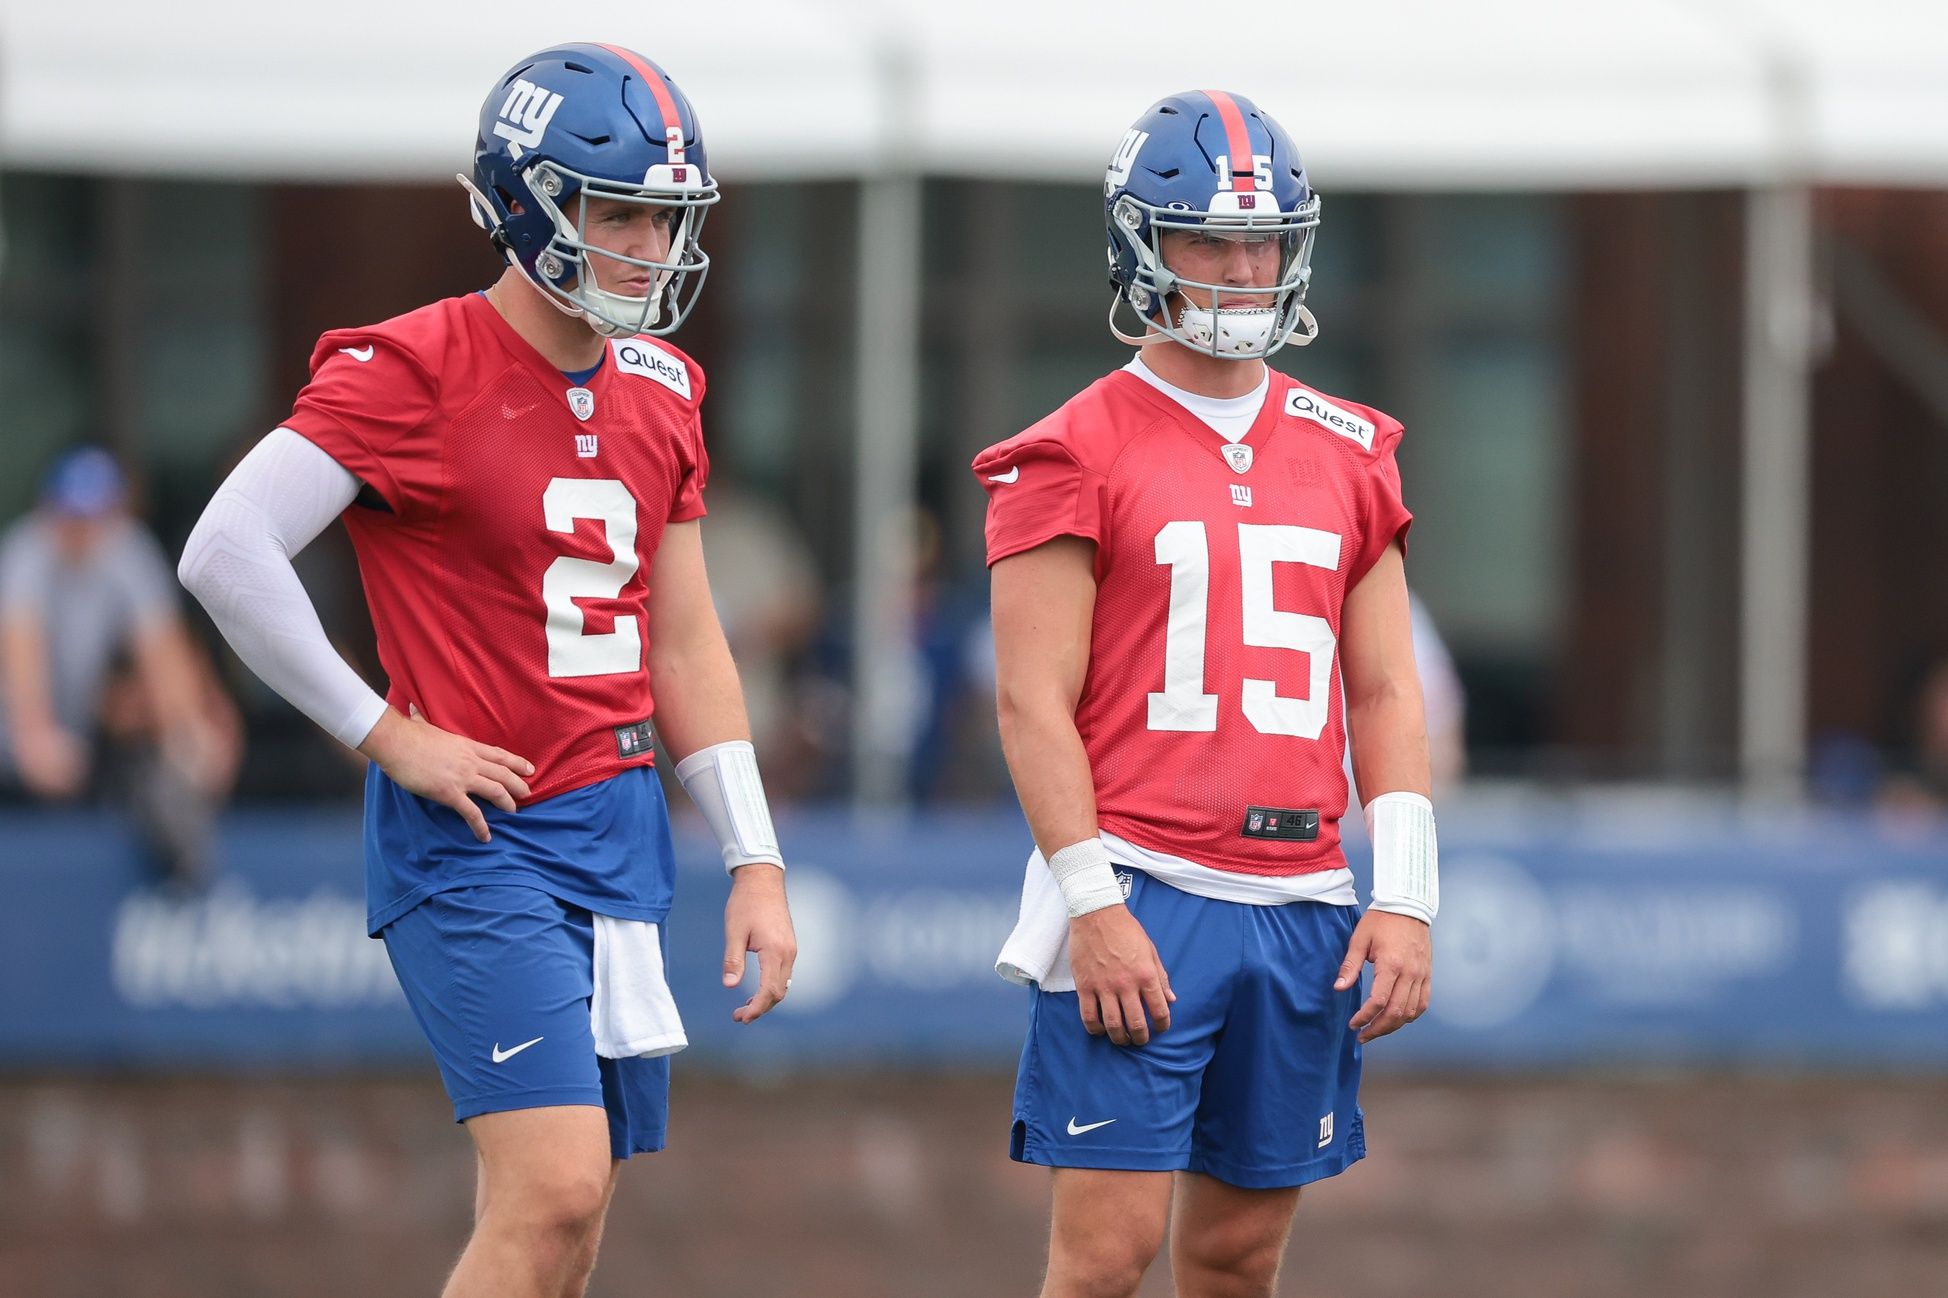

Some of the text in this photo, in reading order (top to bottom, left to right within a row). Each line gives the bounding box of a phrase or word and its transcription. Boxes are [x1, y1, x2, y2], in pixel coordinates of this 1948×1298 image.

[665, 126, 685, 164] 2
[1216, 155, 1273, 191] 15
[620, 347, 685, 386] Quest
[1292, 396, 1370, 440] Quest
[542, 476, 641, 678] 2
[1147, 520, 1343, 741] 15
